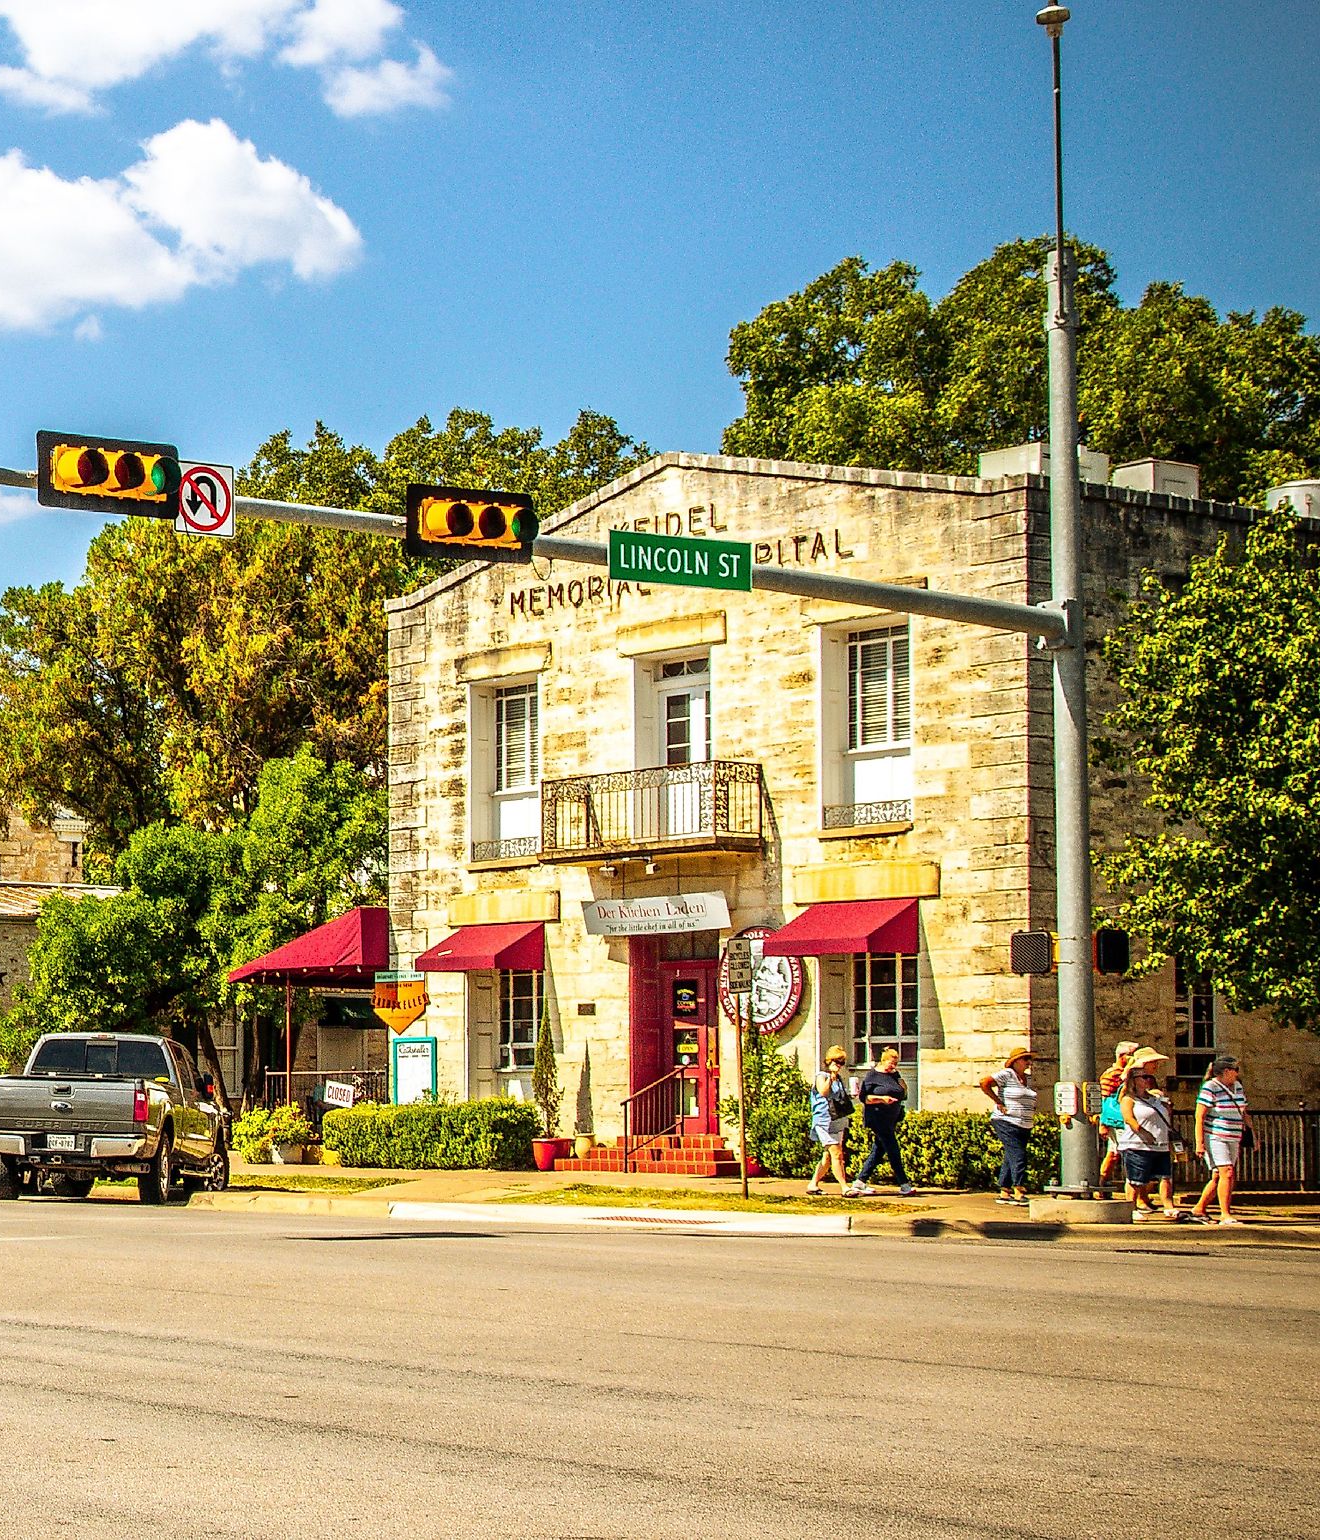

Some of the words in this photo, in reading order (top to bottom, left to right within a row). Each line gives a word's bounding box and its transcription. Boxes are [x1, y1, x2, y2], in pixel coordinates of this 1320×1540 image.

[613, 503, 727, 536] EIDEL
[754, 529, 854, 566] PITAL
[619, 543, 709, 576] LINCOLN
[718, 553, 741, 578] ST
[597, 906, 615, 919] Der
[665, 901, 705, 917] Laden
[618, 924, 627, 932] the
[628, 922, 643, 931] little
[644, 921, 657, 932] chef
[678, 921, 686, 930] of
[327, 1085, 351, 1102] CLOSED
